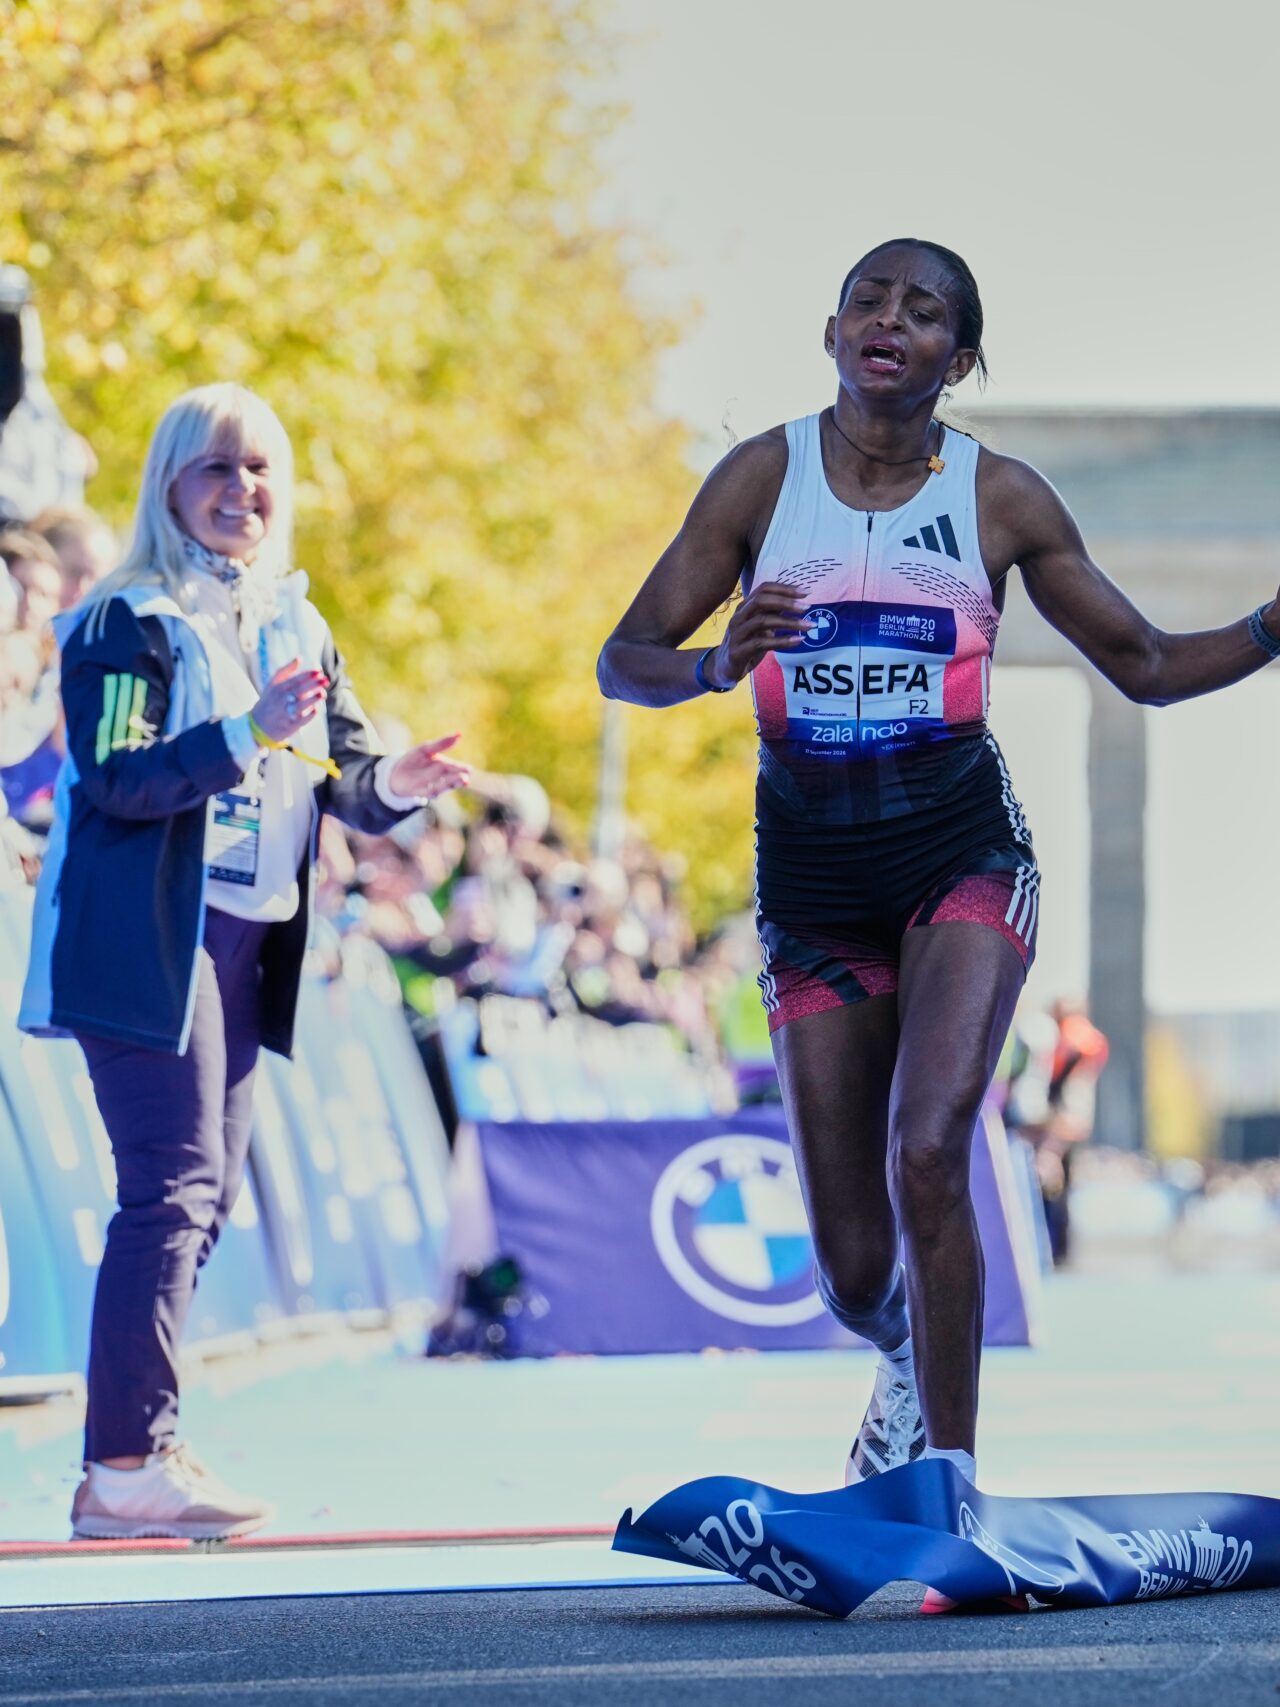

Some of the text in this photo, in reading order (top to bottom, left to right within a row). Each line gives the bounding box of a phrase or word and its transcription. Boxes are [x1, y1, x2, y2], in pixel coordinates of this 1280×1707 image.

[879, 623, 906, 632] BERLIN
[880, 614, 936, 631] BMW 20
[878, 630, 935, 642] MARATHON 26
[793, 663, 929, 695] ASSEFA
[909, 699, 929, 715] F2
[811, 722, 908, 743] zalando
[699, 1499, 764, 1568] 20
[1106, 1529, 1253, 1589] BMW 20
[749, 1545, 817, 1602] 26
